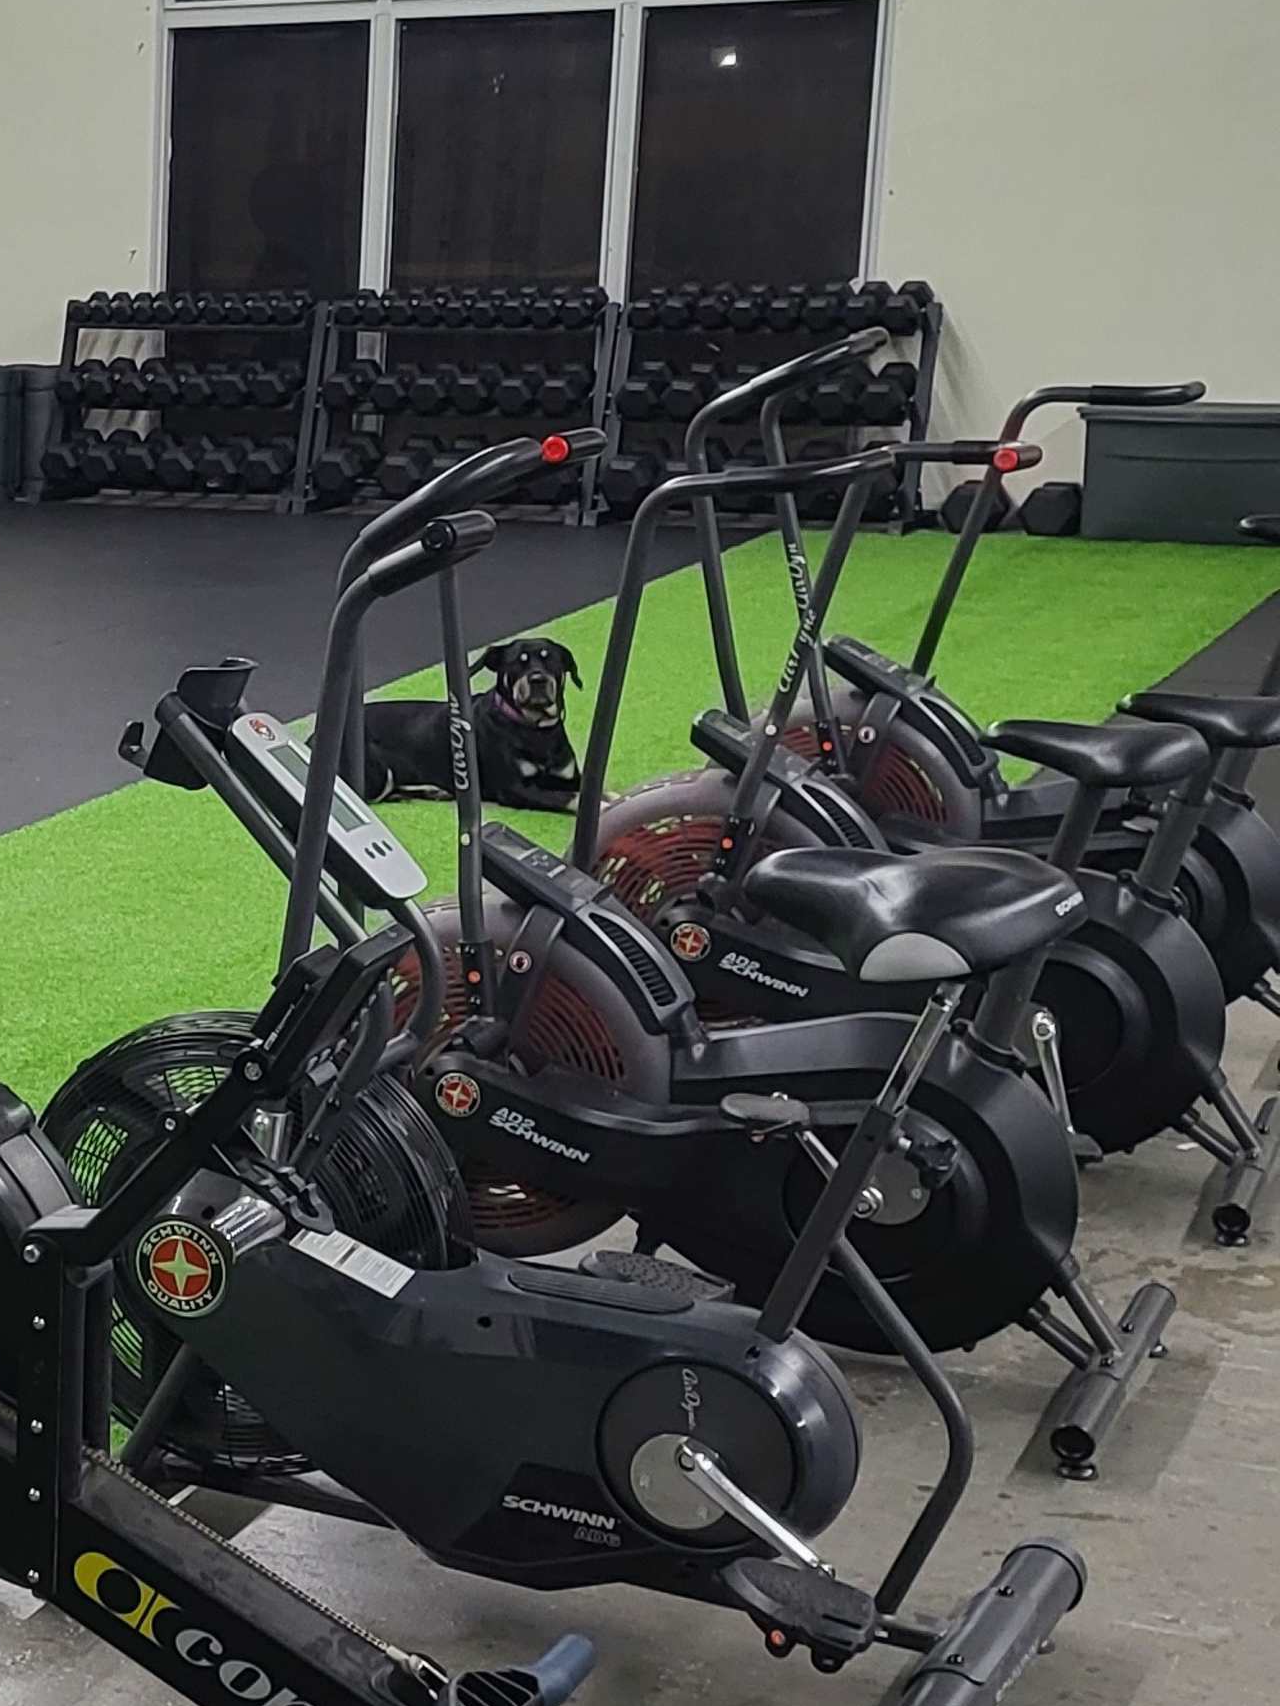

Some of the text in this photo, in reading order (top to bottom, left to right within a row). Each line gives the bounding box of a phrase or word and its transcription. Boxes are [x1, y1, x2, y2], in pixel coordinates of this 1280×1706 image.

[718, 958, 809, 997] SCHWINN
[489, 1115, 590, 1163] SCHWINN
[142, 1225, 220, 1265] SCHWINN
[146, 1279, 214, 1310] QUALITY
[502, 1495, 616, 1530] SCHWINN
